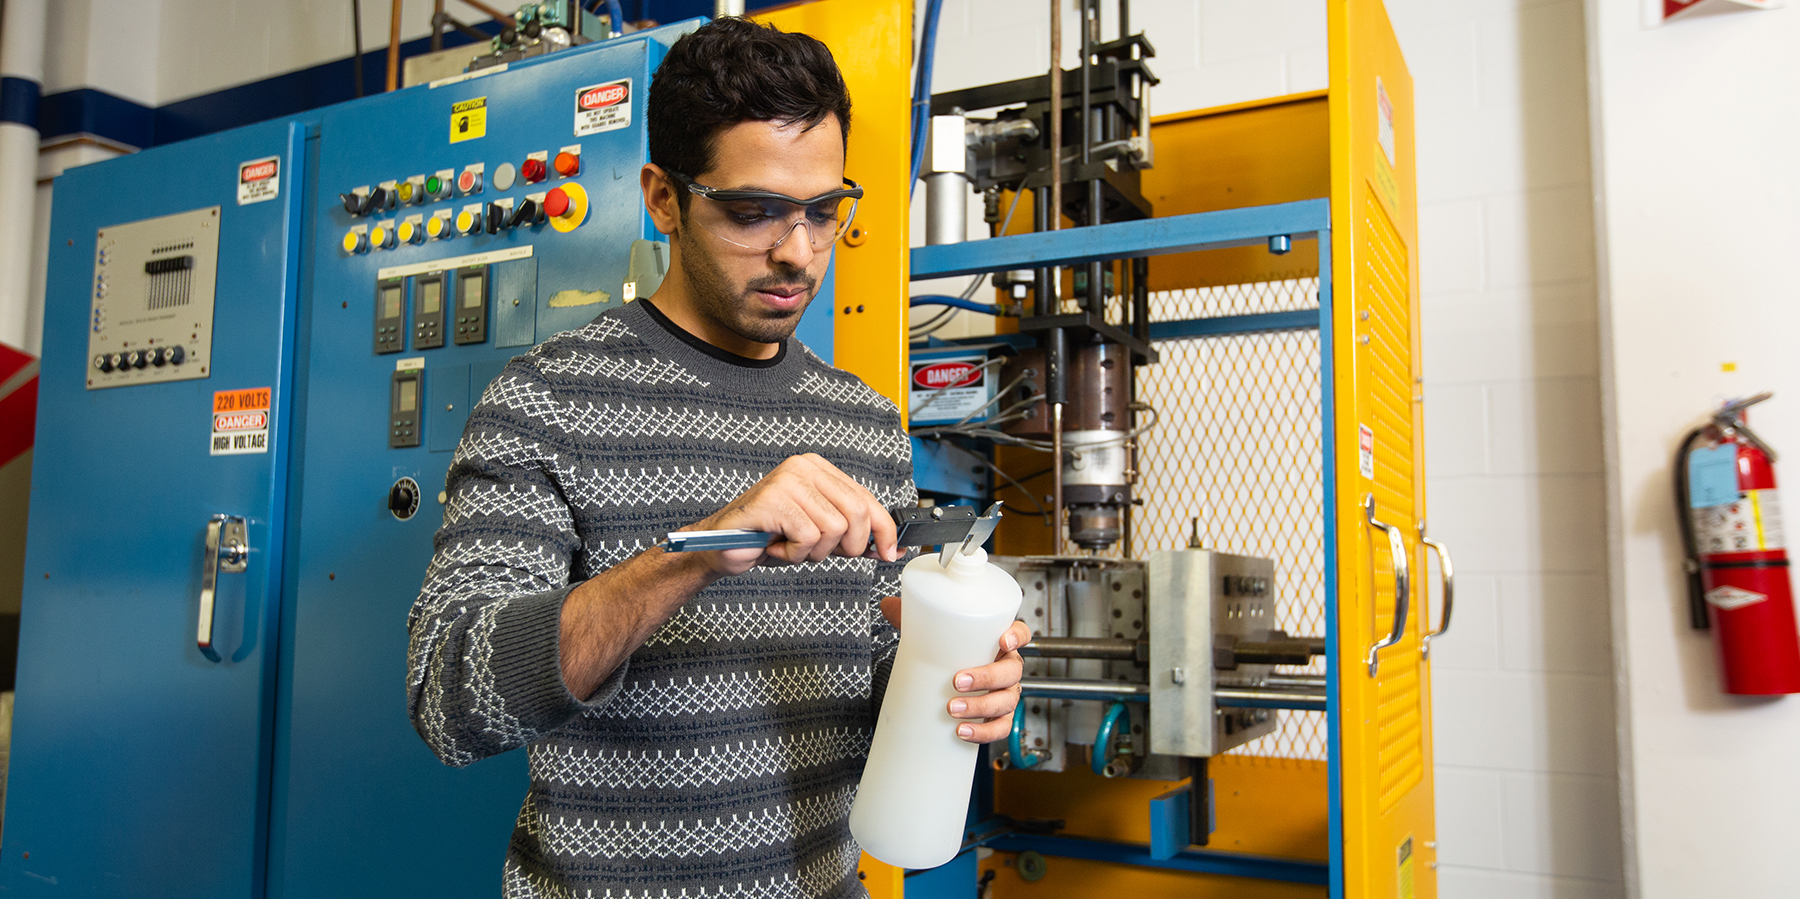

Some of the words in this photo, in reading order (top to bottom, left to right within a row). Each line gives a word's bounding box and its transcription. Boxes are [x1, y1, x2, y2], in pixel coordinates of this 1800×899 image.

[584, 87, 624, 106] DANGER
[454, 100, 484, 113] CAUTION
[245, 164, 275, 179] DANGER
[927, 367, 969, 385] DANGER
[217, 395, 235, 410] 220
[239, 391, 268, 408] VOLTS
[219, 415, 262, 429] DANGER
[213, 436, 230, 450] HIGH
[233, 433, 266, 449] VOLTAGE
